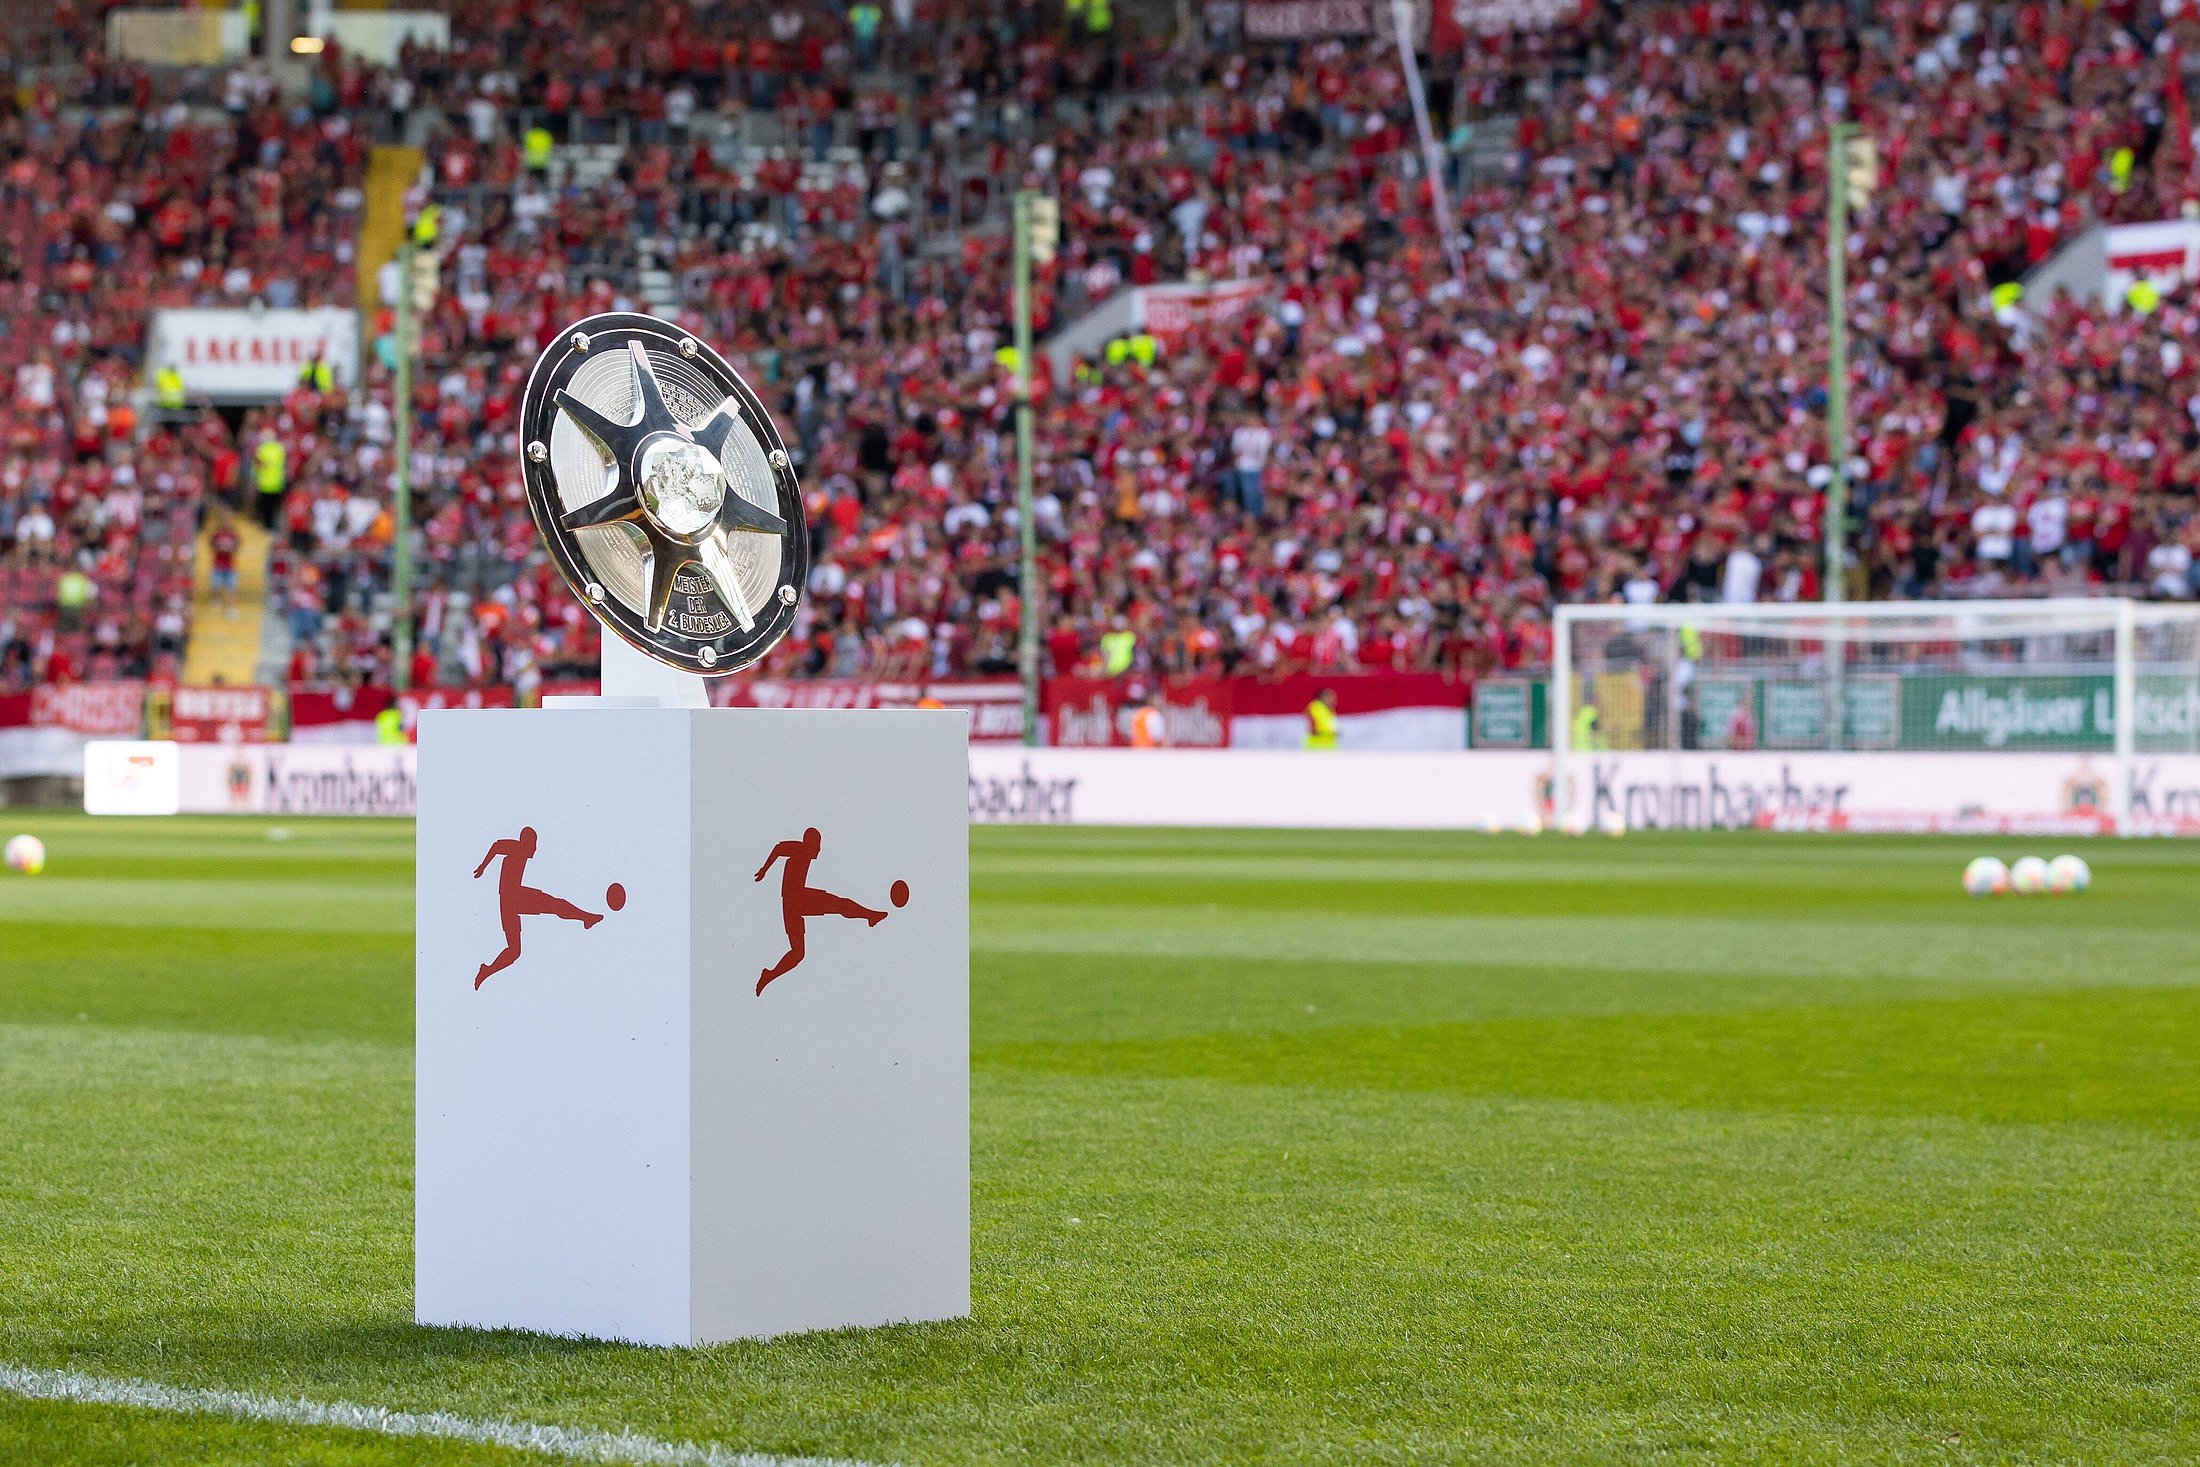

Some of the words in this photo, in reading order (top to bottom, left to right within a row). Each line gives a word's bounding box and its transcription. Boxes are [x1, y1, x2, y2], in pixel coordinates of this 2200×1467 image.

[673, 574, 714, 595] MEISTER
[687, 596, 708, 614] DER
[680, 611, 732, 633] BUNDESLIGA
